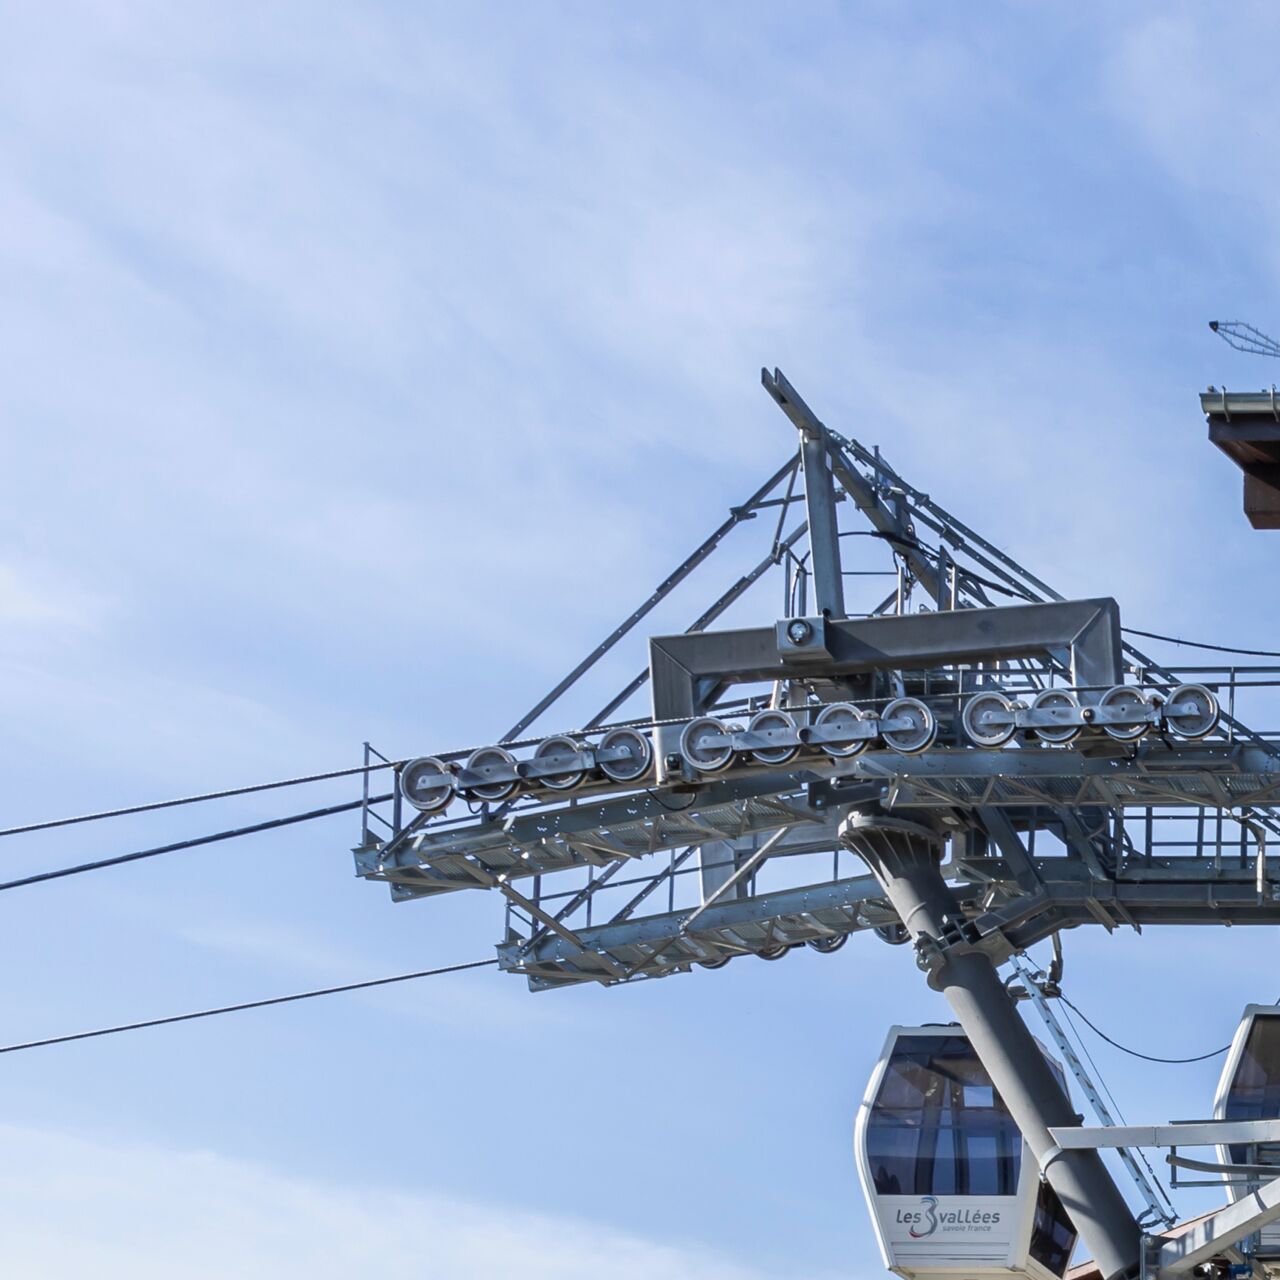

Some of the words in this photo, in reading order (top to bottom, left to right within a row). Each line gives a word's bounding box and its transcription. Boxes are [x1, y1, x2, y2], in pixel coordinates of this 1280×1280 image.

[909, 1196, 939, 1238] 3
[942, 1224, 966, 1232] savoie
[967, 1224, 992, 1232] france
